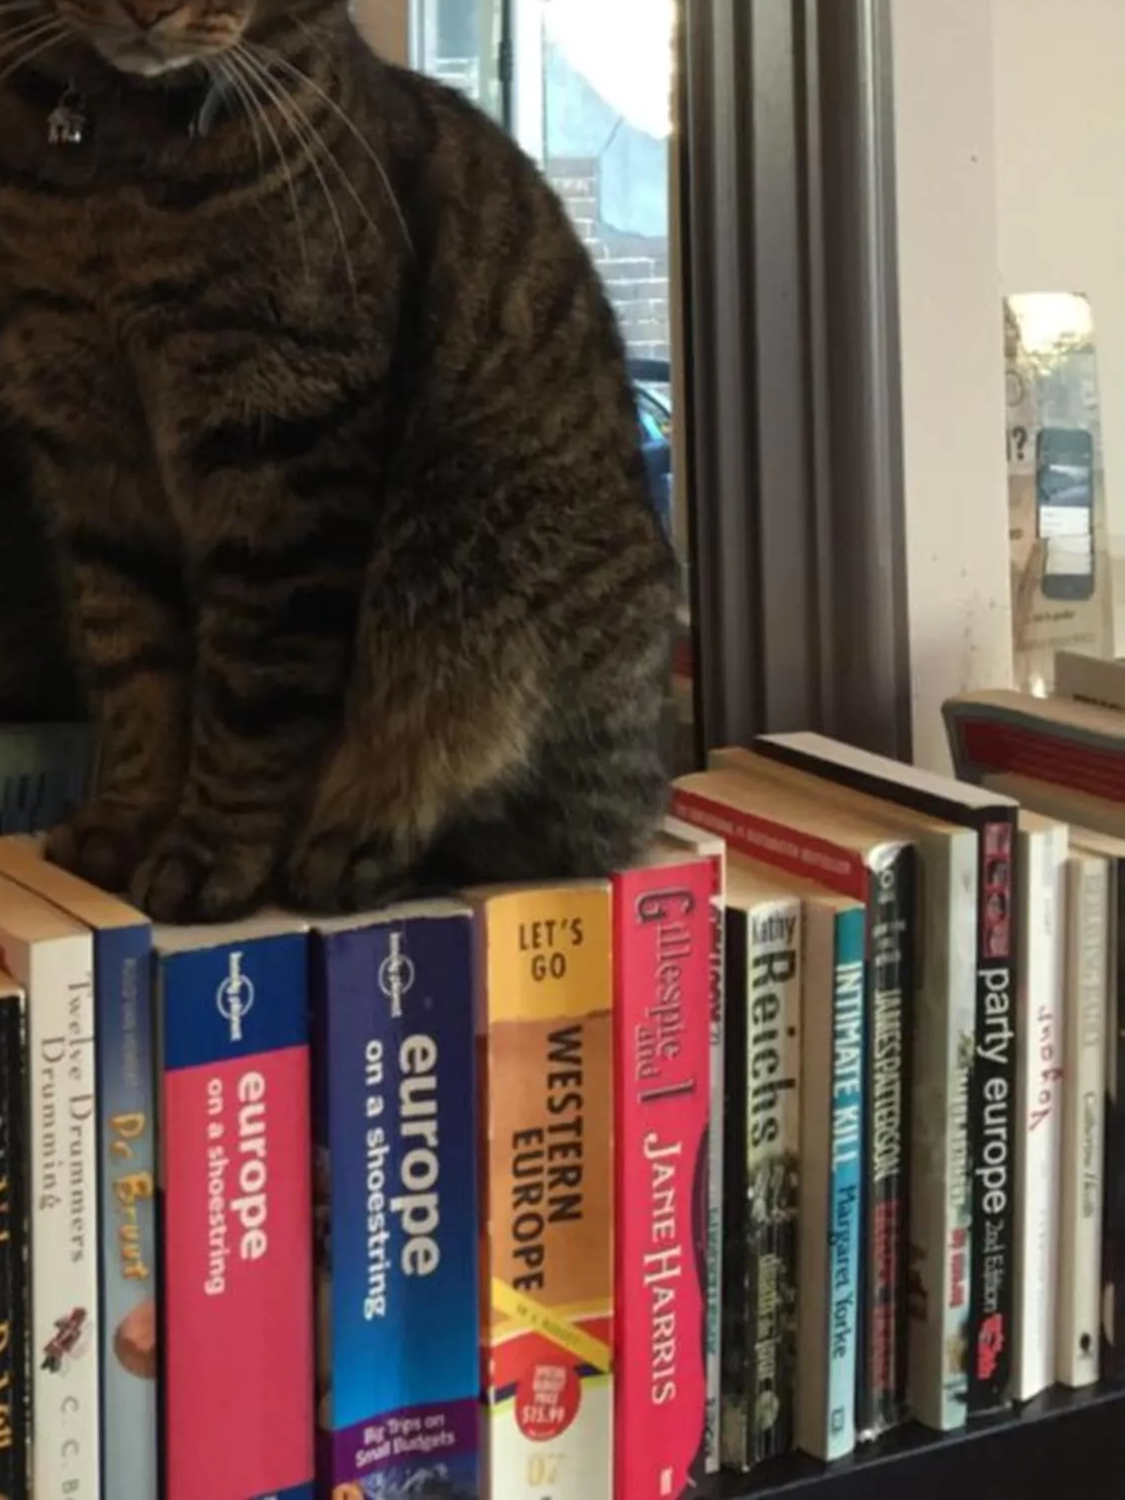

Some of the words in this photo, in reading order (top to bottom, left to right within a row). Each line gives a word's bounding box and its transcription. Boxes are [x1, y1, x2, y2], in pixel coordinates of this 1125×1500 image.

[518, 916, 584, 952] LET'S
[530, 952, 567, 983] GO
[635, 888, 695, 1060] Gillespie
[67, 972, 96, 1083] Twelve
[363, 1038, 384, 1088] on
[634, 1023, 660, 1082] and
[751, 949, 797, 1149] Reichs
[832, 960, 865, 1103] INTIMATE
[977, 967, 1011, 1066] party
[38, 1036, 66, 1211] Drumming
[205, 1077, 223, 1118] on
[206, 1123, 224, 1143] a
[366, 1095, 385, 1119] a
[546, 1024, 583, 1223] WESTERN
[638, 1076, 696, 1103] I
[831, 1106, 862, 1174] KILL
[975, 1075, 1011, 1215] europe
[67, 1093, 96, 1264] Drummers
[230, 1070, 268, 1262] europe
[391, 1033, 441, 1277] europe
[511, 1126, 545, 1293] EUROPE
[641, 1131, 682, 1243] JANE
[204, 1146, 232, 1298] shoestring
[363, 1125, 393, 1324] shoestring
[827, 1184, 859, 1289] Margaret
[984, 1218, 1006, 1253] 2nd
[641, 1245, 682, 1406] HARRIS
[830, 1296, 855, 1359] Yorke
[983, 1253, 1005, 1314] Edition
